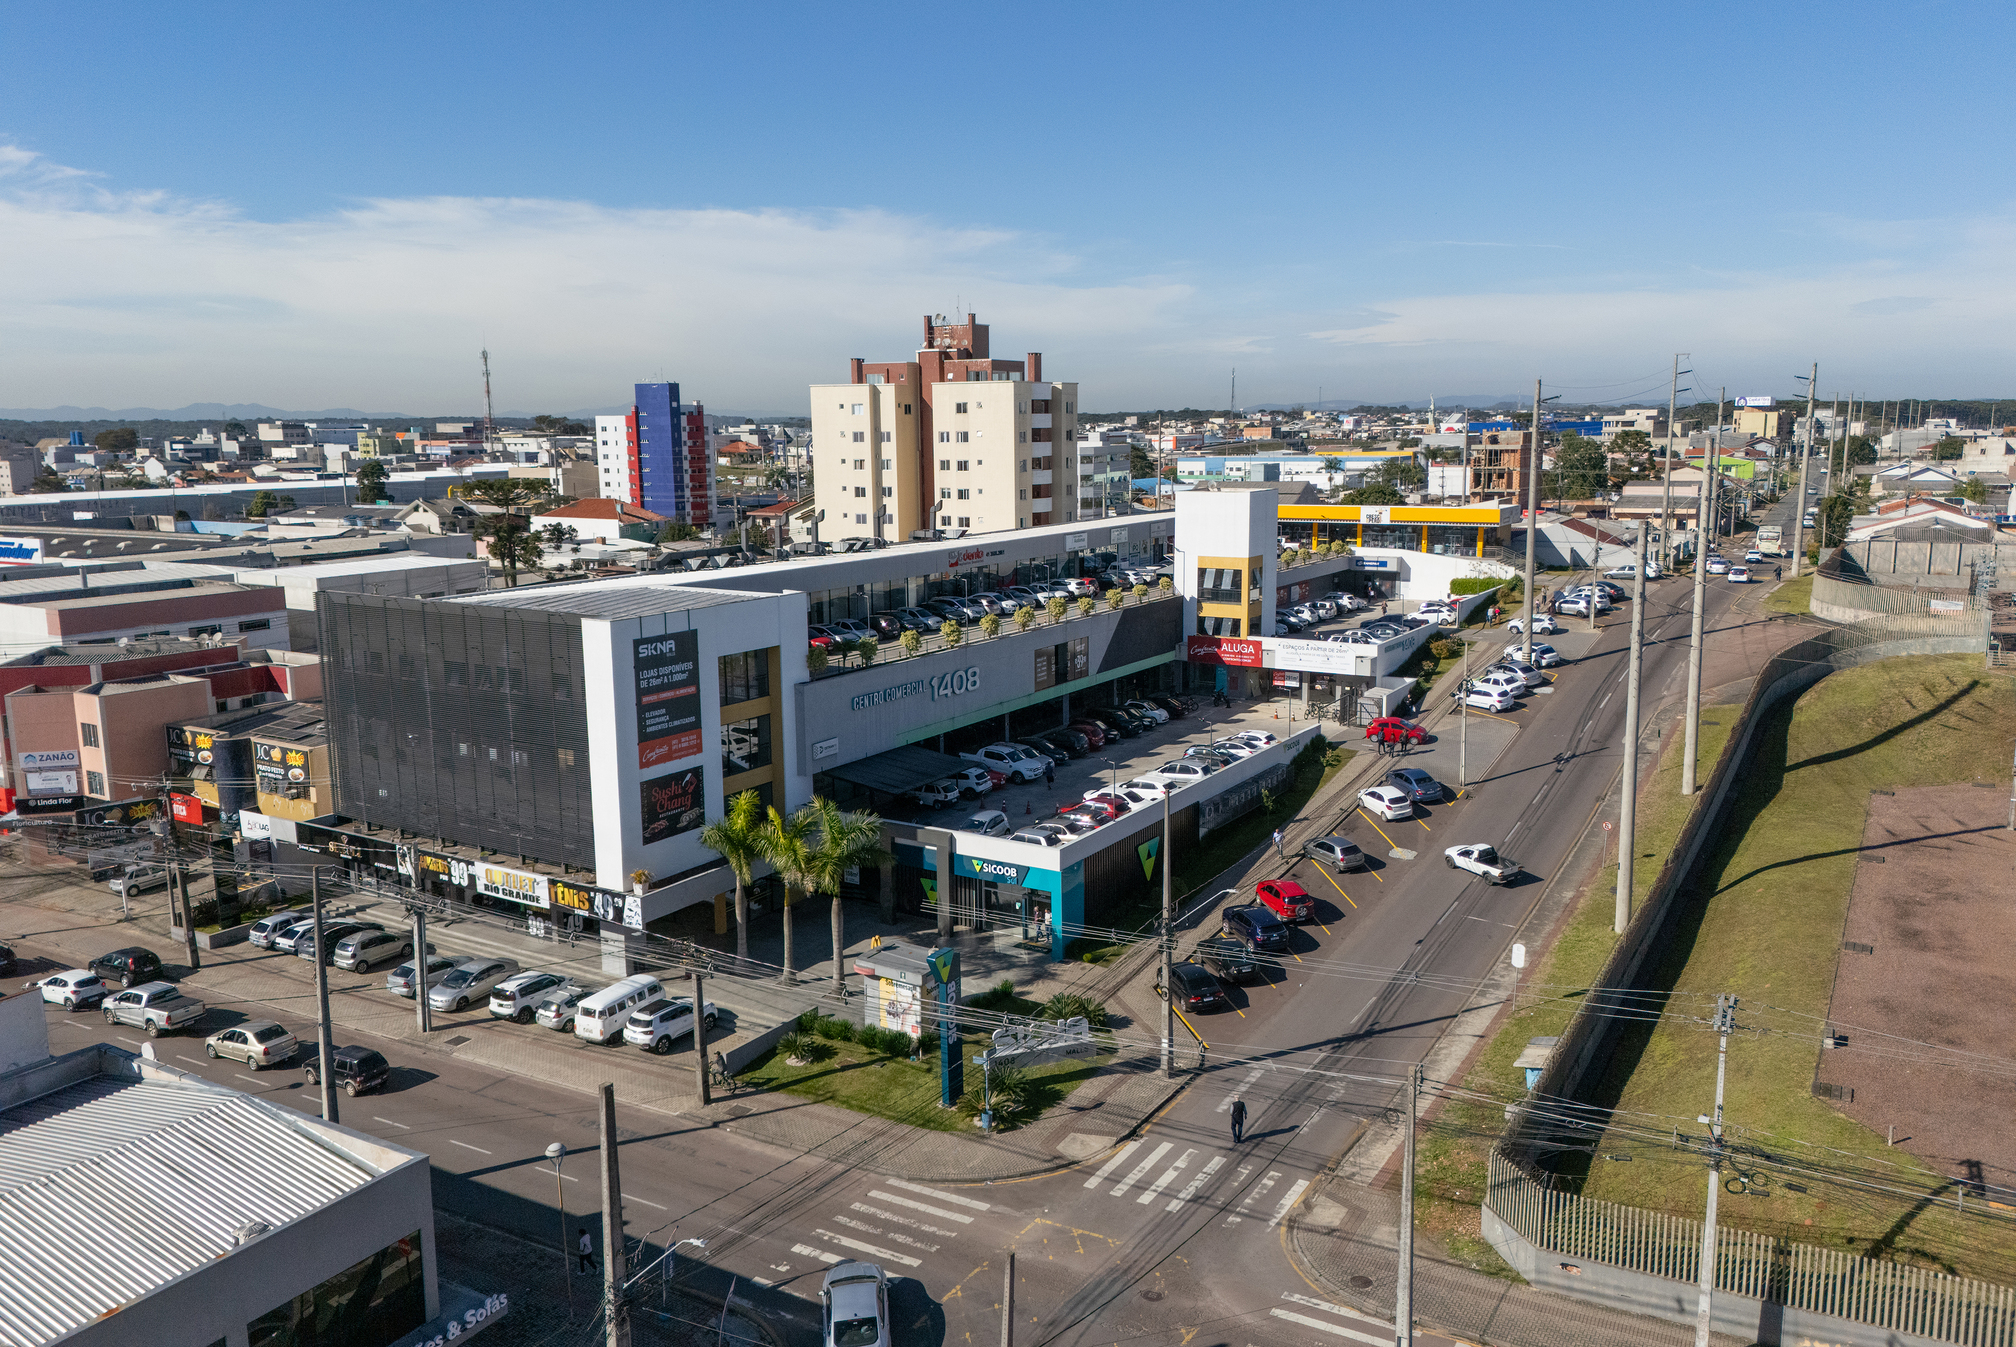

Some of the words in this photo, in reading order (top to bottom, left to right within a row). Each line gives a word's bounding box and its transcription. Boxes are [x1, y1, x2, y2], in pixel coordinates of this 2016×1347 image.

[638, 640, 676, 658] SKNA
[1221, 643, 1255, 654] ALUGA
[1282, 644, 1305, 652] ESPAÇOS
[640, 668, 658, 679] LOJAS
[659, 661, 693, 676] DISPONÍVEIS
[640, 680, 649, 688] DE
[852, 690, 884, 711] CENTRO
[885, 680, 927, 702] COMERCIAL
[930, 665, 980, 702] 1408
[38, 752, 75, 762] ZANÃO
[652, 781, 682, 802] Sushi
[657, 794, 692, 814] Chang
[983, 862, 1017, 878] SICOOB
[484, 868, 536, 895] OUTLET
[484, 884, 500, 895] RIO
[502, 887, 542, 905] GRANDE
[947, 980, 958, 1045] SICOOB
[446, 1320, 462, 1341] &
[463, 1293, 508, 1329] Sofás
